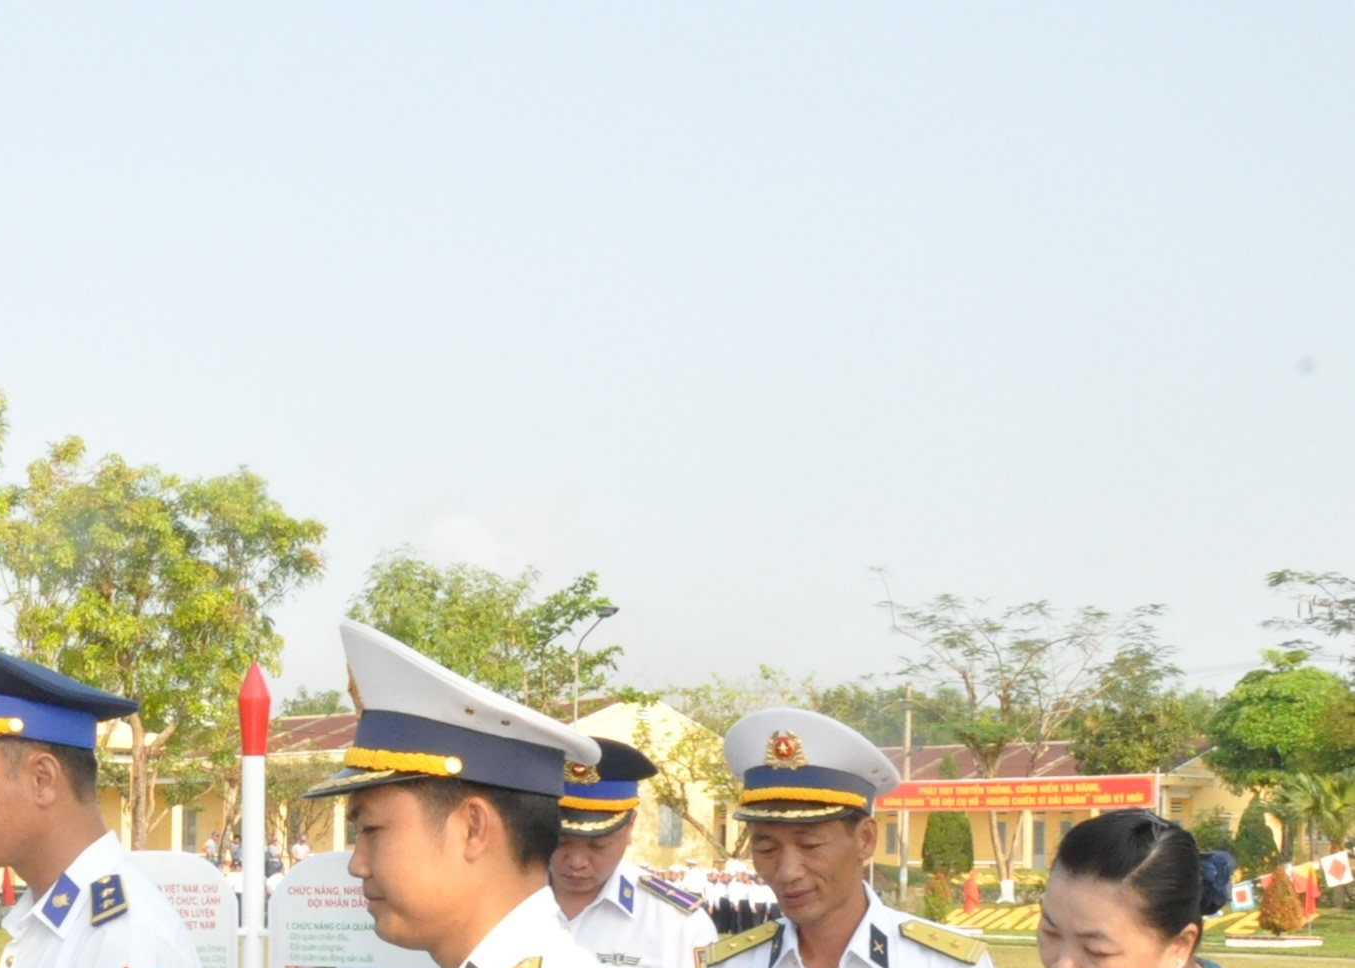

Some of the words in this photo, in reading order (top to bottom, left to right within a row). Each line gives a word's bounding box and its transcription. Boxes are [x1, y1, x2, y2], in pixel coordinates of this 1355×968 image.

[288, 886, 312, 895] CHỨC
[308, 898, 323, 909] ĐỘI
[325, 898, 349, 908] NHÂN
[200, 921, 216, 929] NAM
[291, 921, 312, 930] CHỨC
[313, 922, 334, 930] NĂNG
[336, 922, 351, 930] CỦA
